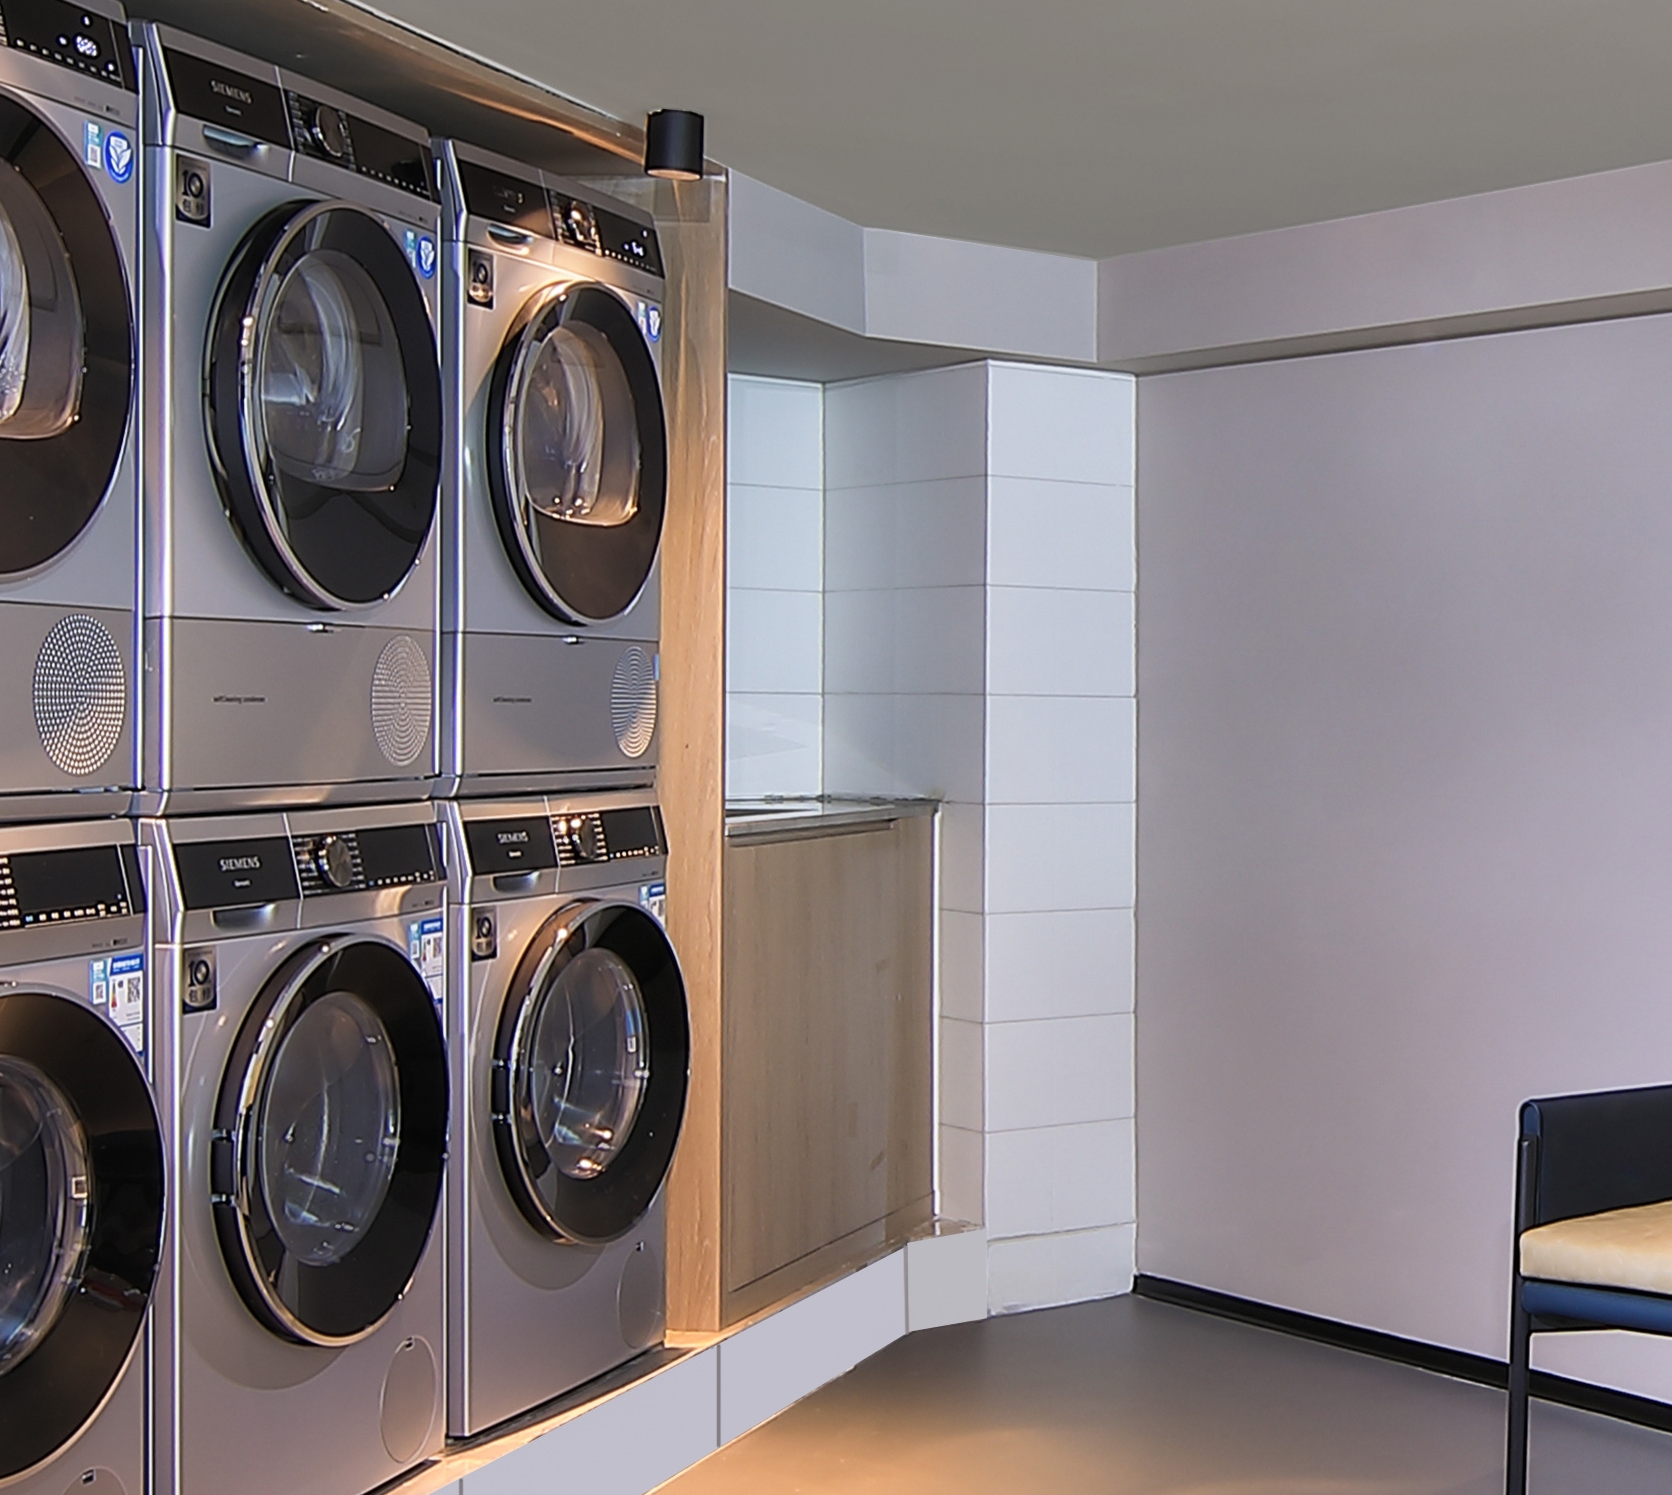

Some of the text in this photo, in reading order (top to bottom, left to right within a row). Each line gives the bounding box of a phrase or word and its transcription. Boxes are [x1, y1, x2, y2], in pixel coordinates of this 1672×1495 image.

[210, 80, 253, 104] SIEMENS
[182, 169, 204, 198] 10
[220, 856, 260, 871] SIEMENS
[188, 960, 210, 987] 10
